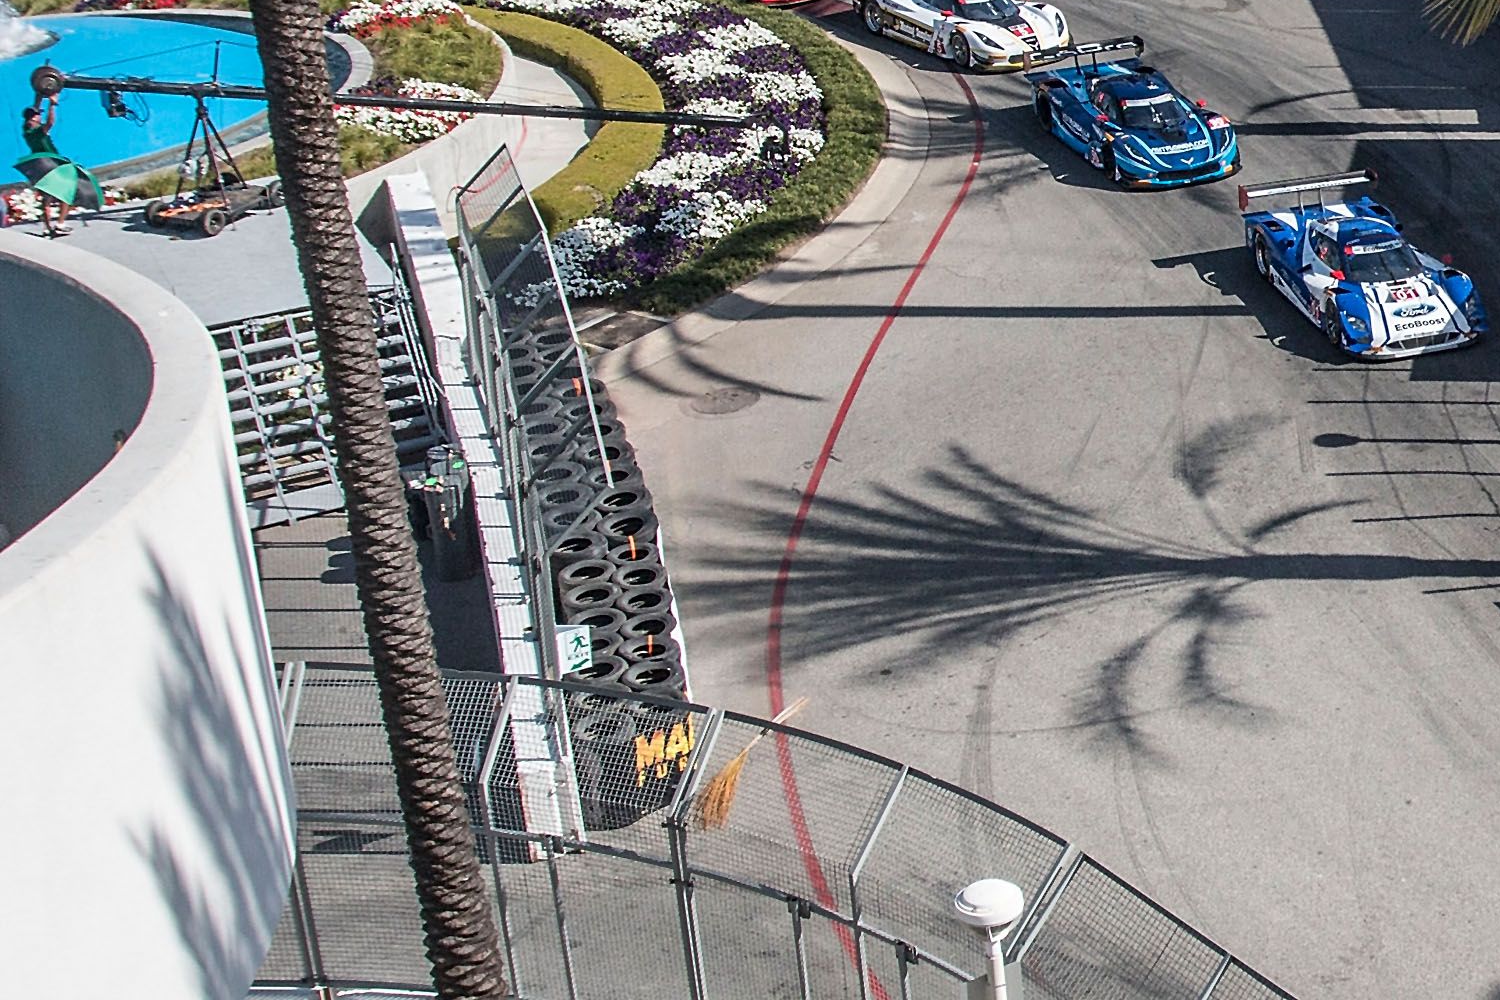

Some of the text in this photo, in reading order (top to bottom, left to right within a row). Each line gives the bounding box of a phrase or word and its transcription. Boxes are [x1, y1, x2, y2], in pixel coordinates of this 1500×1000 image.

[1396, 288, 1418, 301] 01
[1400, 303, 1430, 318] Ford
[1394, 317, 1446, 332] EcoBoost
